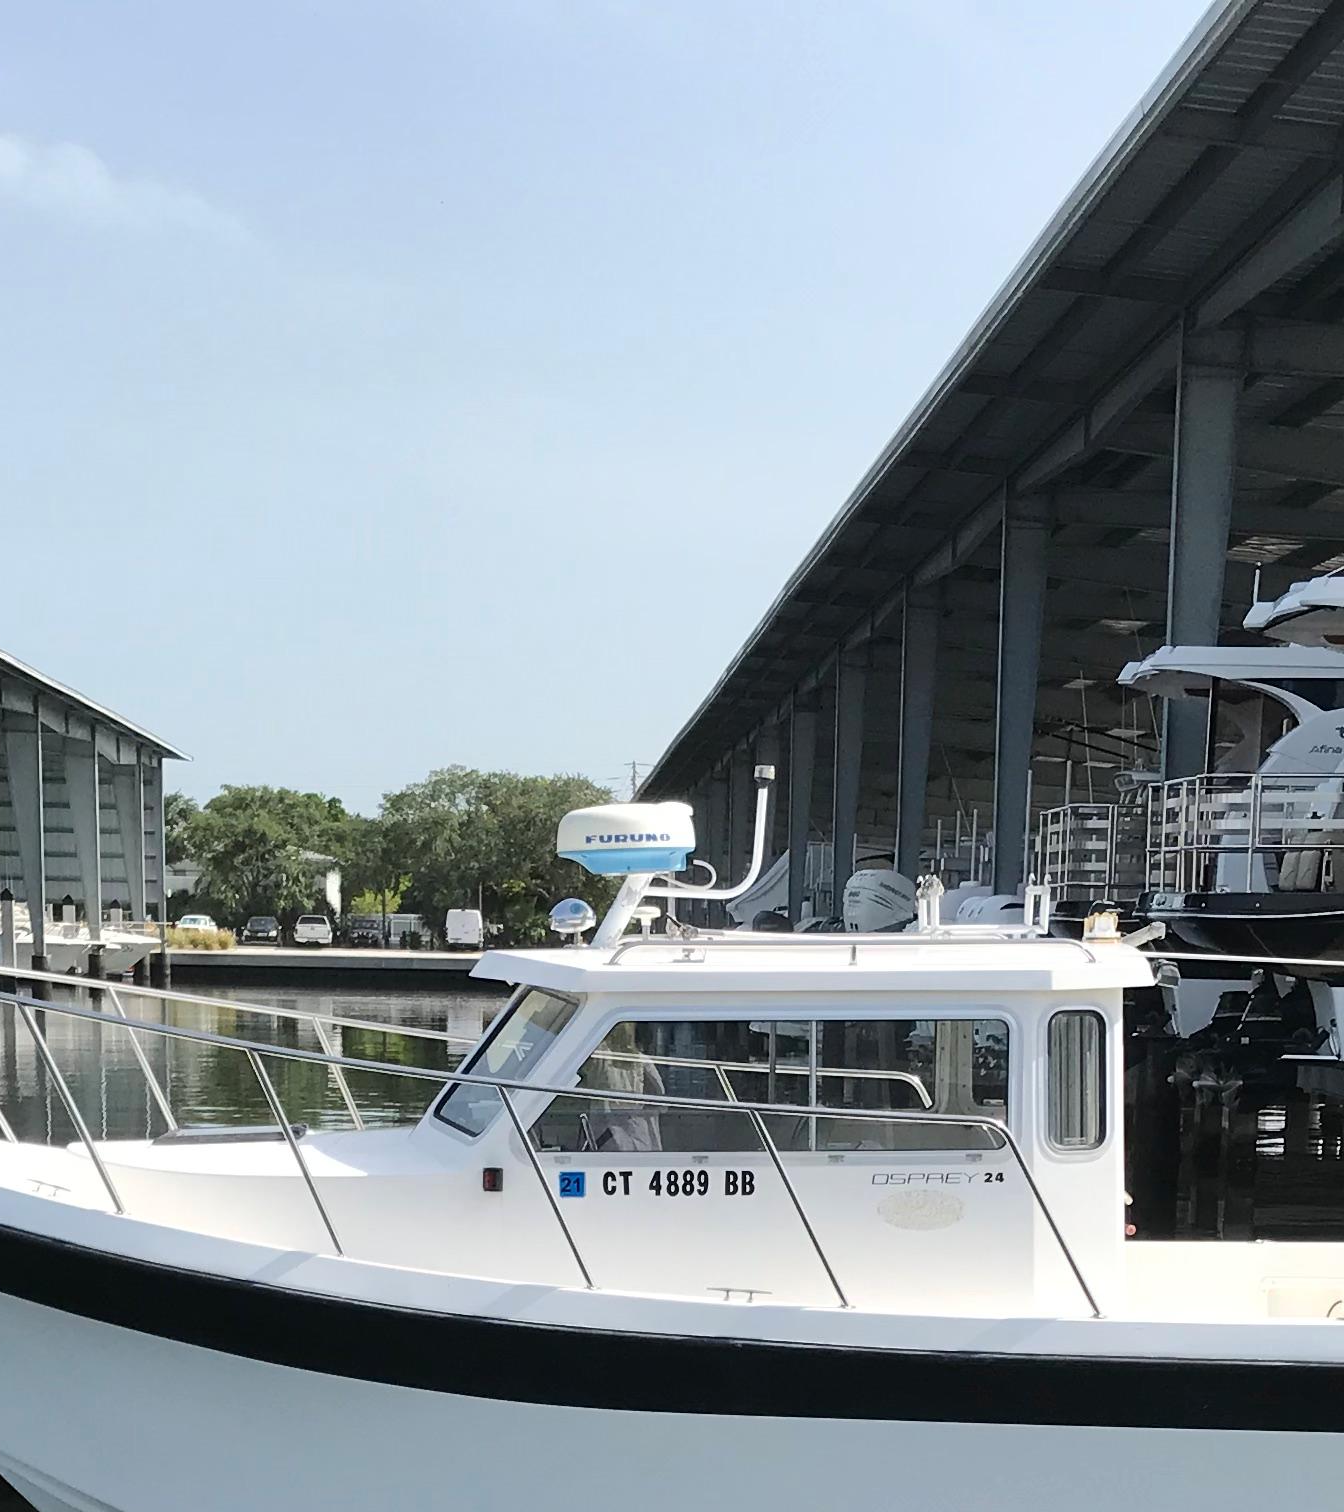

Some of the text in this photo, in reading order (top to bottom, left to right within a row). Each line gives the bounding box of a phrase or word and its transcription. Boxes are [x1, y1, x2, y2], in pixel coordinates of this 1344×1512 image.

[585, 833, 671, 844] FURUNO
[560, 1177, 582, 1193] 21
[602, 1170, 755, 1197] CT 4889 BB
[871, 1172, 1005, 1185] OSPREY 24
